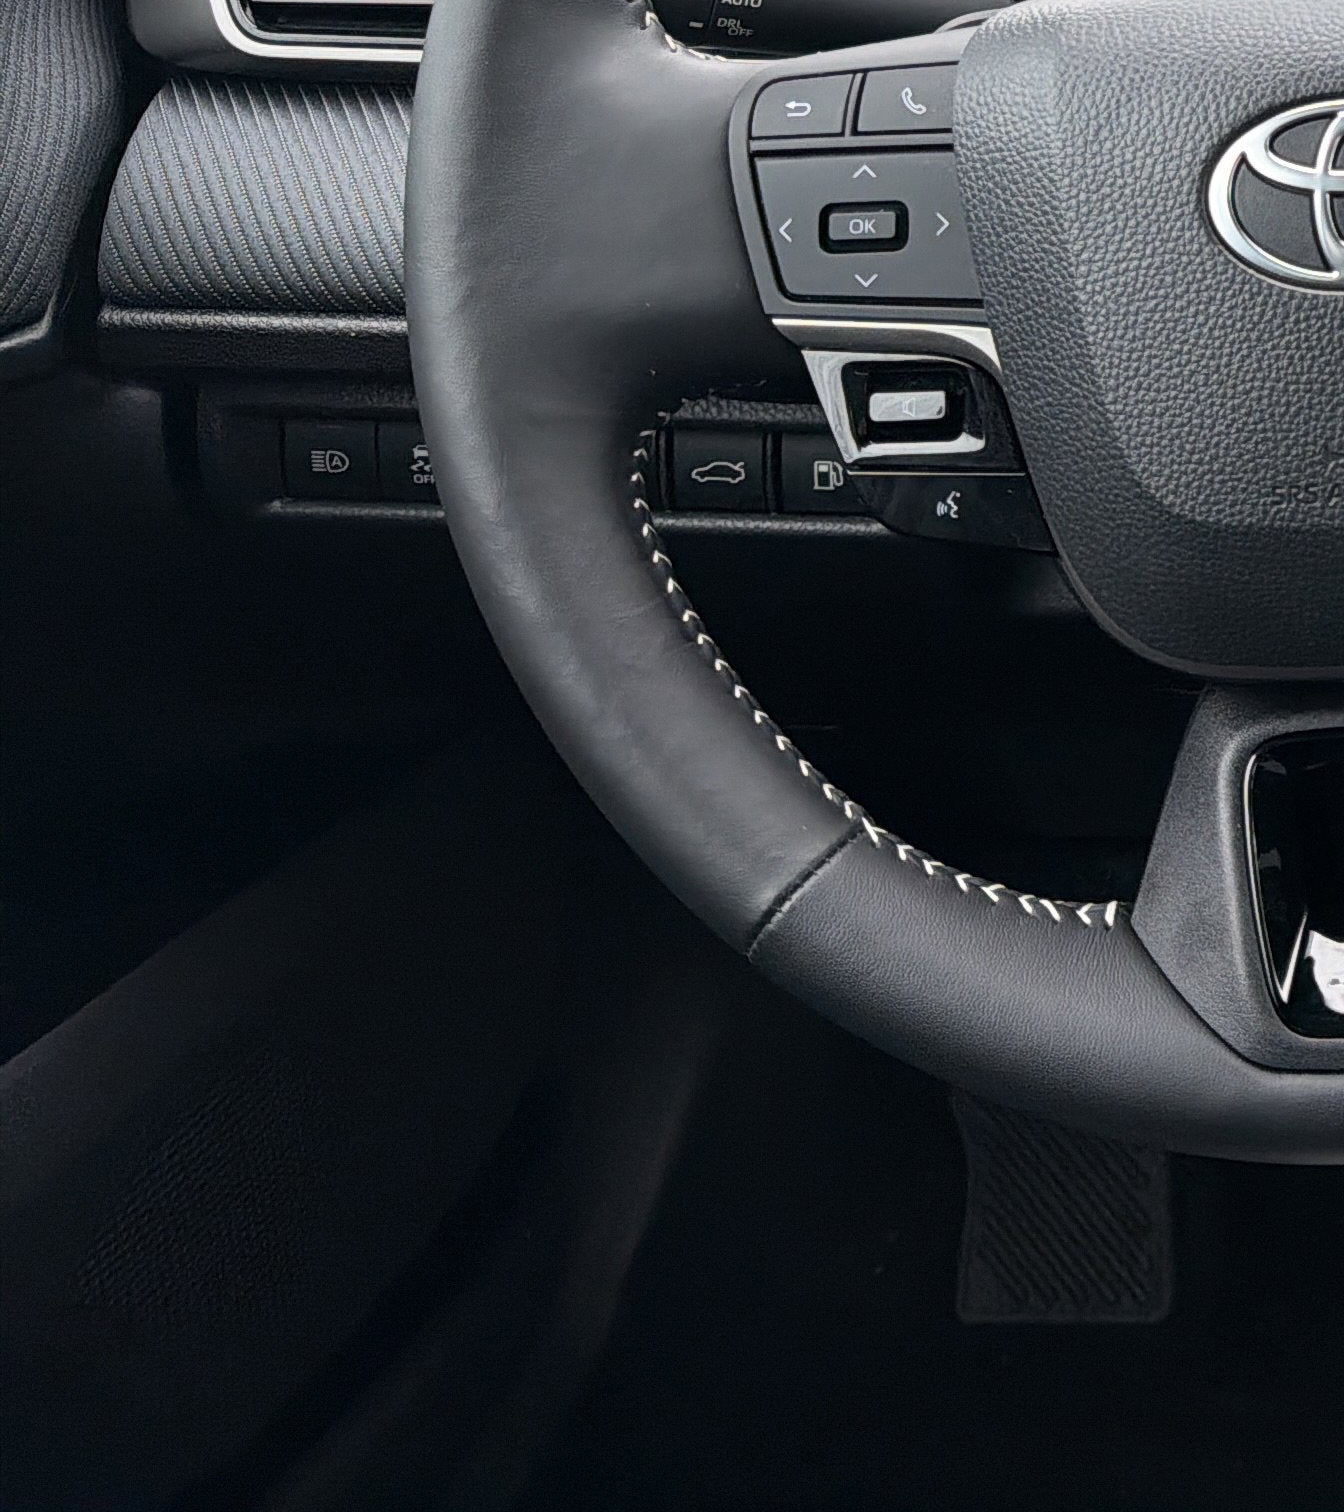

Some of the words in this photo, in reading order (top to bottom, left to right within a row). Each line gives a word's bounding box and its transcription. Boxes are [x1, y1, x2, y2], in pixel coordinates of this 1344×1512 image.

[717, 17, 743, 29] DRL
[728, 27, 754, 37] OFF
[848, 218, 877, 235] OK
